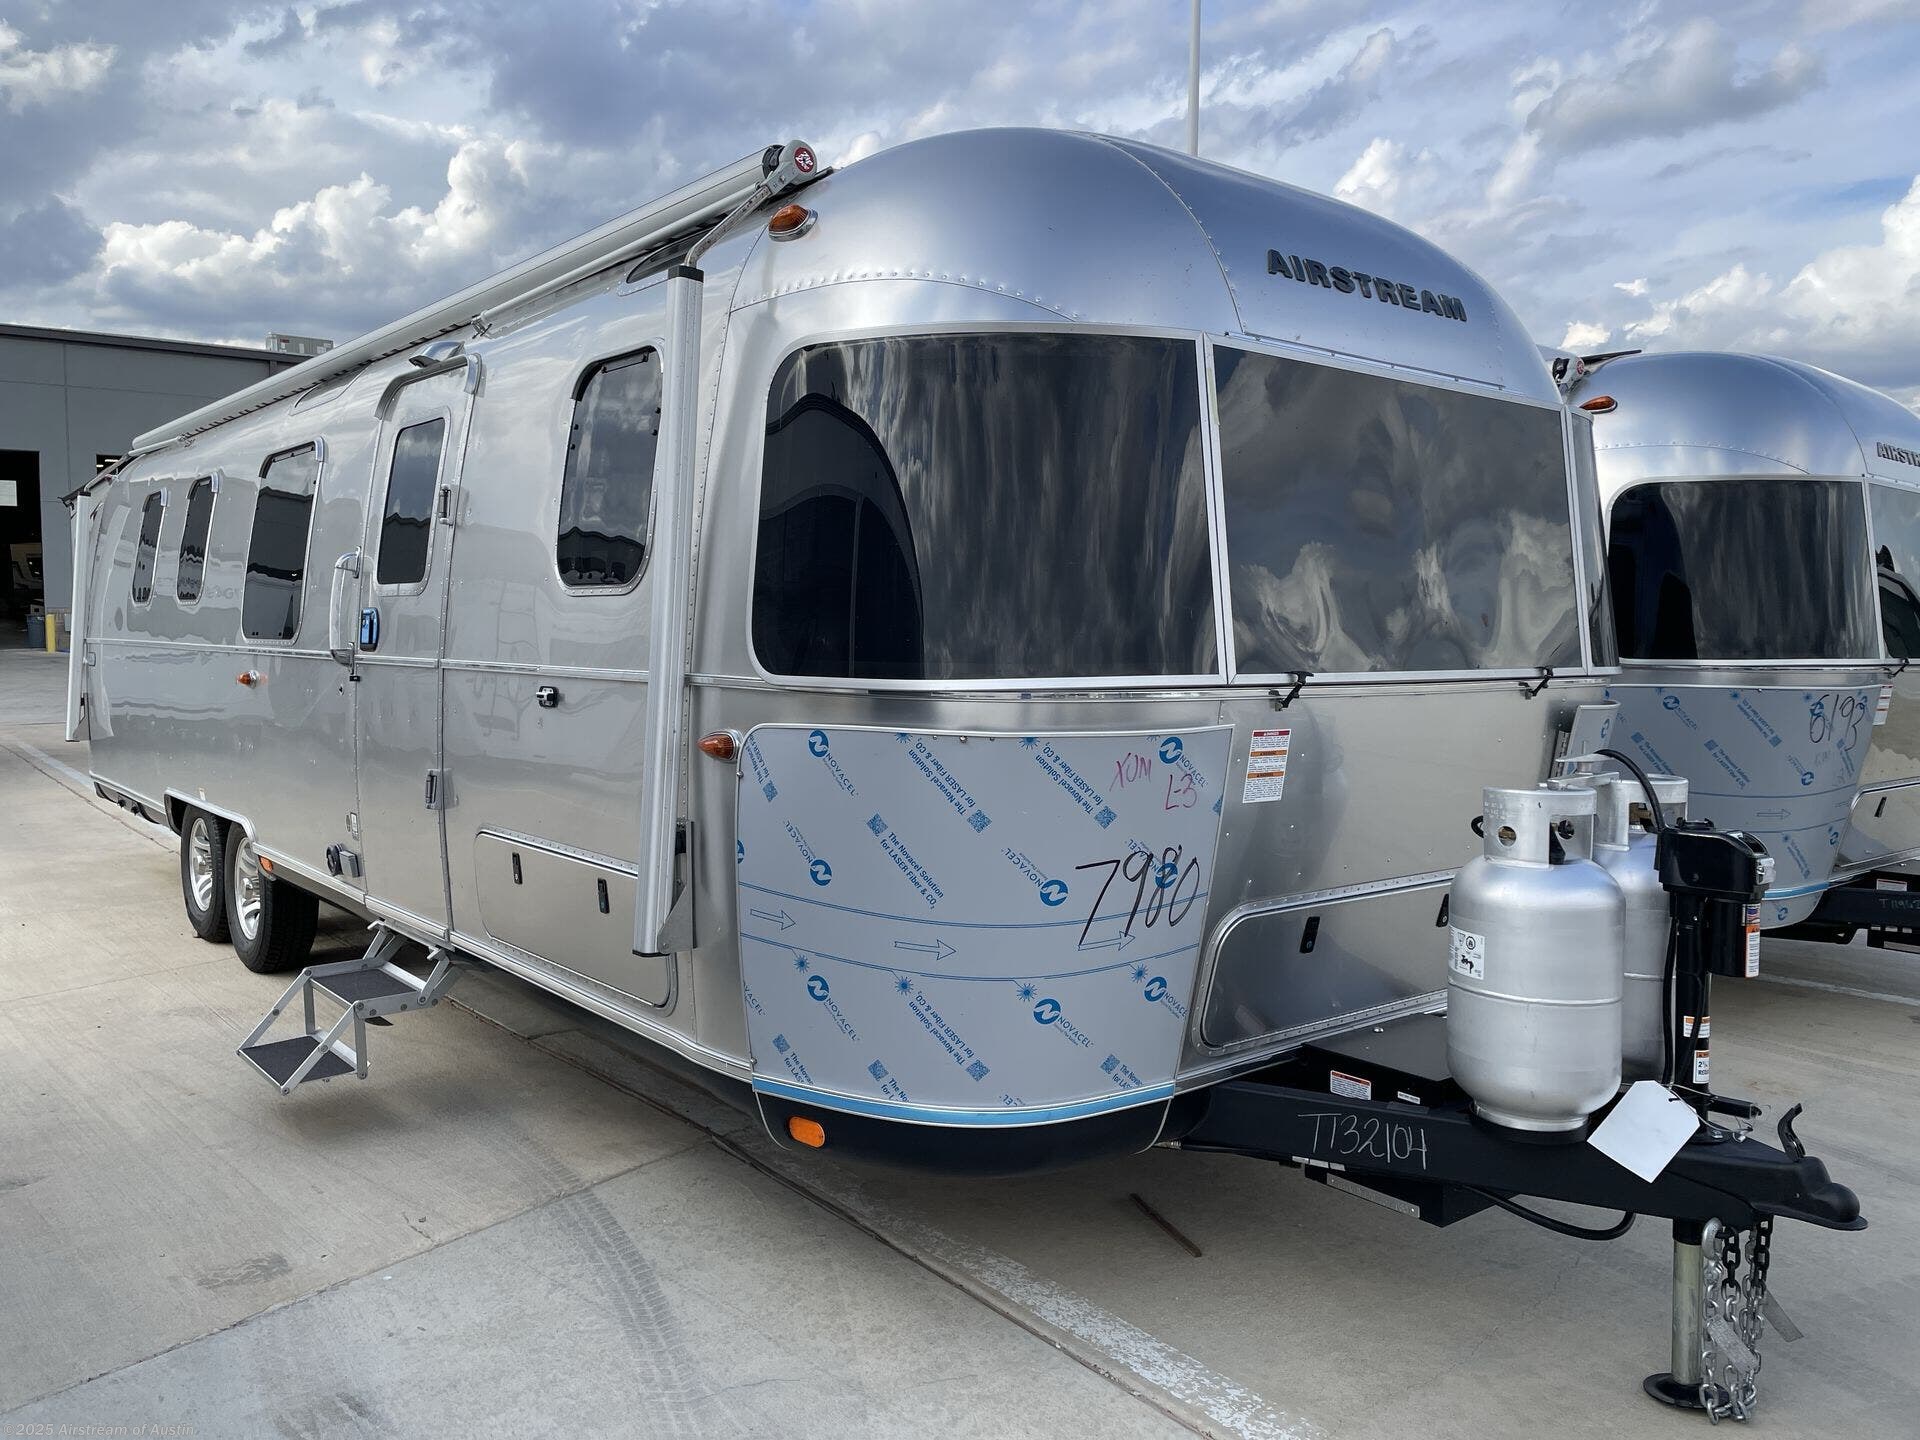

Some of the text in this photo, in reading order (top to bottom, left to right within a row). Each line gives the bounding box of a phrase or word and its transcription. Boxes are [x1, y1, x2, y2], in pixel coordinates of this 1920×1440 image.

[1267, 249, 1467, 322] AIRSTREAM
[825, 752, 857, 797] NOVACEL
[930, 758, 948, 777] Fiber
[1059, 761, 1076, 779] Fiber
[1180, 754, 1206, 788] NOVACEL
[908, 749, 967, 815] The Novacel Solution
[945, 774, 967, 798] LASER
[1035, 754, 1094, 814] The Novacel Solution
[1073, 775, 1095, 797] LASER
[965, 796, 976, 808] for
[1093, 793, 1104, 806] for
[785, 820, 813, 864] NOVACEL
[880, 838, 891, 851] for
[888, 848, 909, 873] LASER
[905, 870, 923, 889] Fiber
[888, 832, 945, 898] The Novacel Solution
[1005, 848, 1044, 887] NOVACEL
[1075, 844, 1200, 947] 7980
[1164, 993, 1187, 1017] NOVACE
[827, 998, 857, 1041] NOVACEL
[930, 1010, 947, 1029] Fiber
[908, 1001, 966, 1065] The Novacel Solution
[944, 1026, 966, 1050] LASER
[1058, 1016, 1090, 1048] NOVACEL
[784, 1057, 793, 1068] for
[790, 1052, 800, 1065] The
[964, 1047, 975, 1059] for
[880, 1084, 891, 1096] for
[888, 1078, 900, 1092] The
